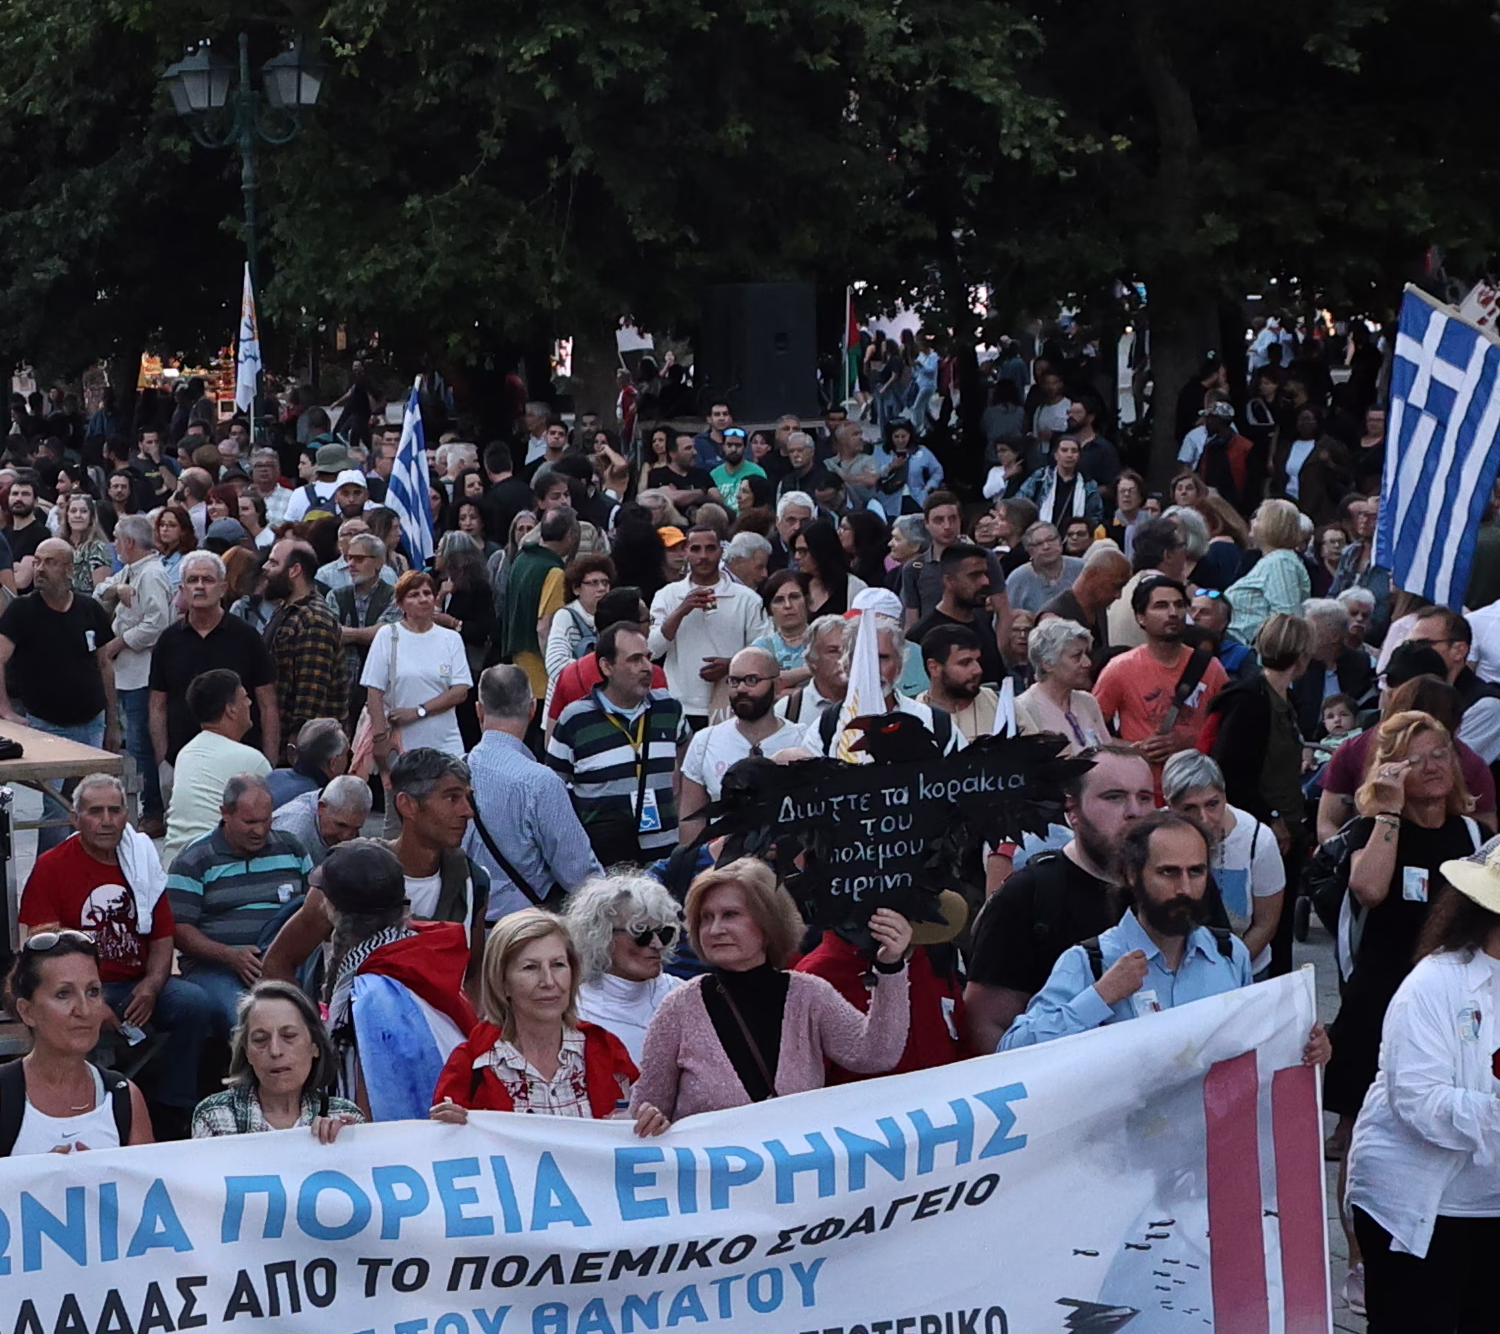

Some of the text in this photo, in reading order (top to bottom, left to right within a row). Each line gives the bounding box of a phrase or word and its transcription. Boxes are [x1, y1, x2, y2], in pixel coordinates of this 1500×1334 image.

[859, 813, 914, 837] του
[880, 785, 910, 807] τα
[221, 1151, 592, 1243] ΠΟΡΕΙΑ
[614, 1081, 1029, 1221] ΕΙΡΗΝΗΣ
[223, 1257, 338, 1322] ΑΠΟ
[357, 1256, 430, 1298] ΤΟ
[446, 1234, 758, 1292] ΠΟΛΕΜΙΚΟ
[765, 1173, 1001, 1256] ΣΦΑΓΕΙΟ
